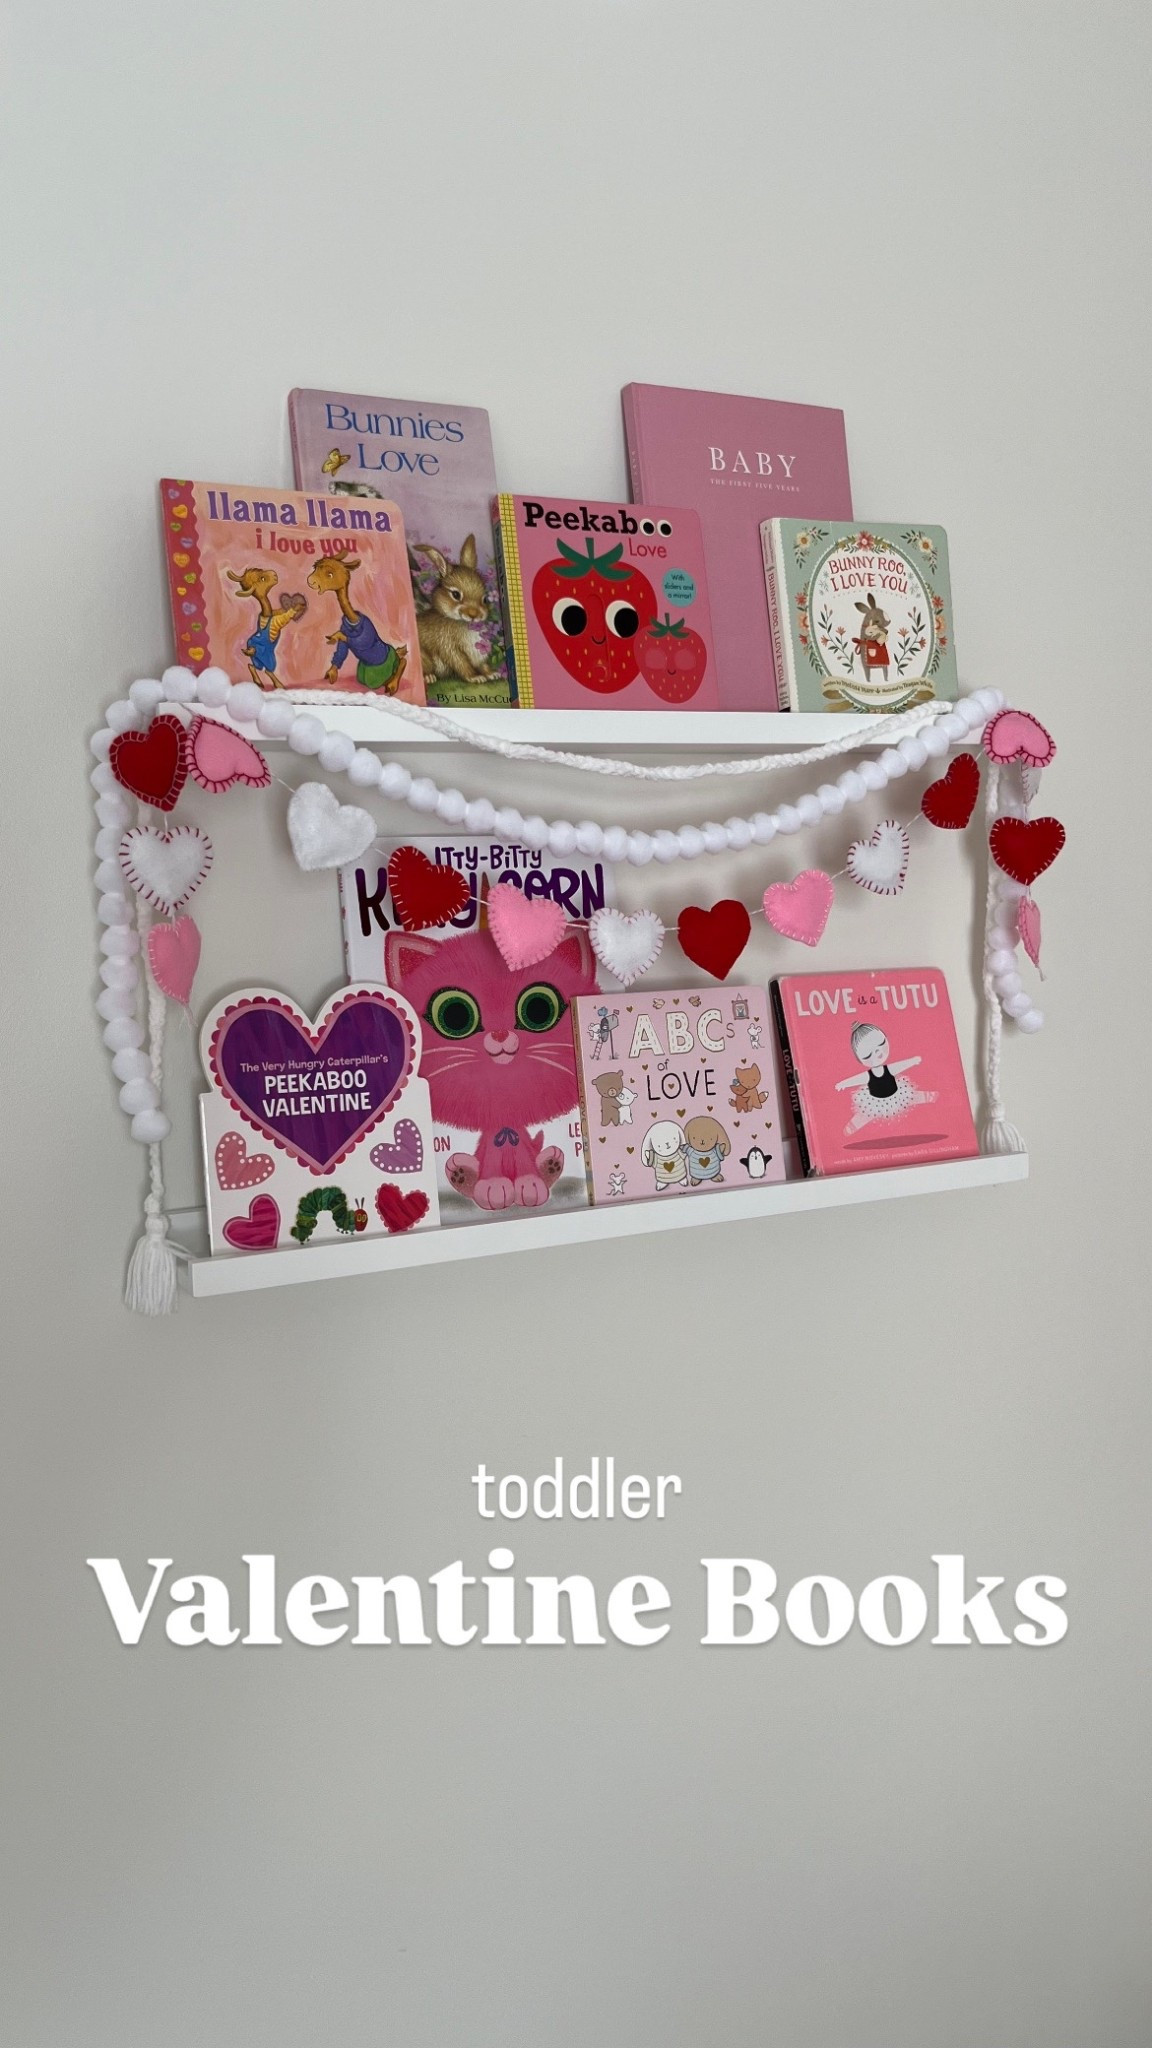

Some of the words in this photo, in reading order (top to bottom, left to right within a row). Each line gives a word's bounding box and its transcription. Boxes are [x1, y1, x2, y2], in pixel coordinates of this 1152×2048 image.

[325, 403, 464, 442] Bunnies
[358, 443, 440, 476] Love
[708, 446, 796, 478] BABY
[710, 478, 725, 486] THE
[207, 490, 298, 526] llama
[306, 499, 392, 533] llama
[523, 502, 673, 538] Peekaboo
[255, 528, 262, 549] i
[270, 531, 315, 555] love
[320, 537, 358, 557] you
[629, 537, 667, 559] Love
[828, 556, 874, 575] BUNNY
[877, 557, 906, 577] ROO,
[830, 577, 839, 592] I
[840, 572, 876, 590] LOVE
[879, 574, 908, 594] YOU
[774, 636, 783, 661] LOVE
[777, 662, 785, 681] YOU
[436, 693, 451, 704] By
[454, 694, 477, 703] Lisa
[795, 988, 857, 1016] LOVE
[857, 995, 867, 1005] is
[870, 995, 877, 1004] a
[875, 983, 938, 1011] TUTU
[240, 1062, 259, 1073] The
[262, 1061, 286, 1073] Very
[288, 1059, 325, 1071] Hungry
[328, 1054, 388, 1067] Caterpillar's
[657, 1058, 670, 1072] of
[264, 1069, 367, 1095] PEEKABOO
[647, 1069, 717, 1101] LOVE
[262, 1092, 372, 1118] VALENTINE
